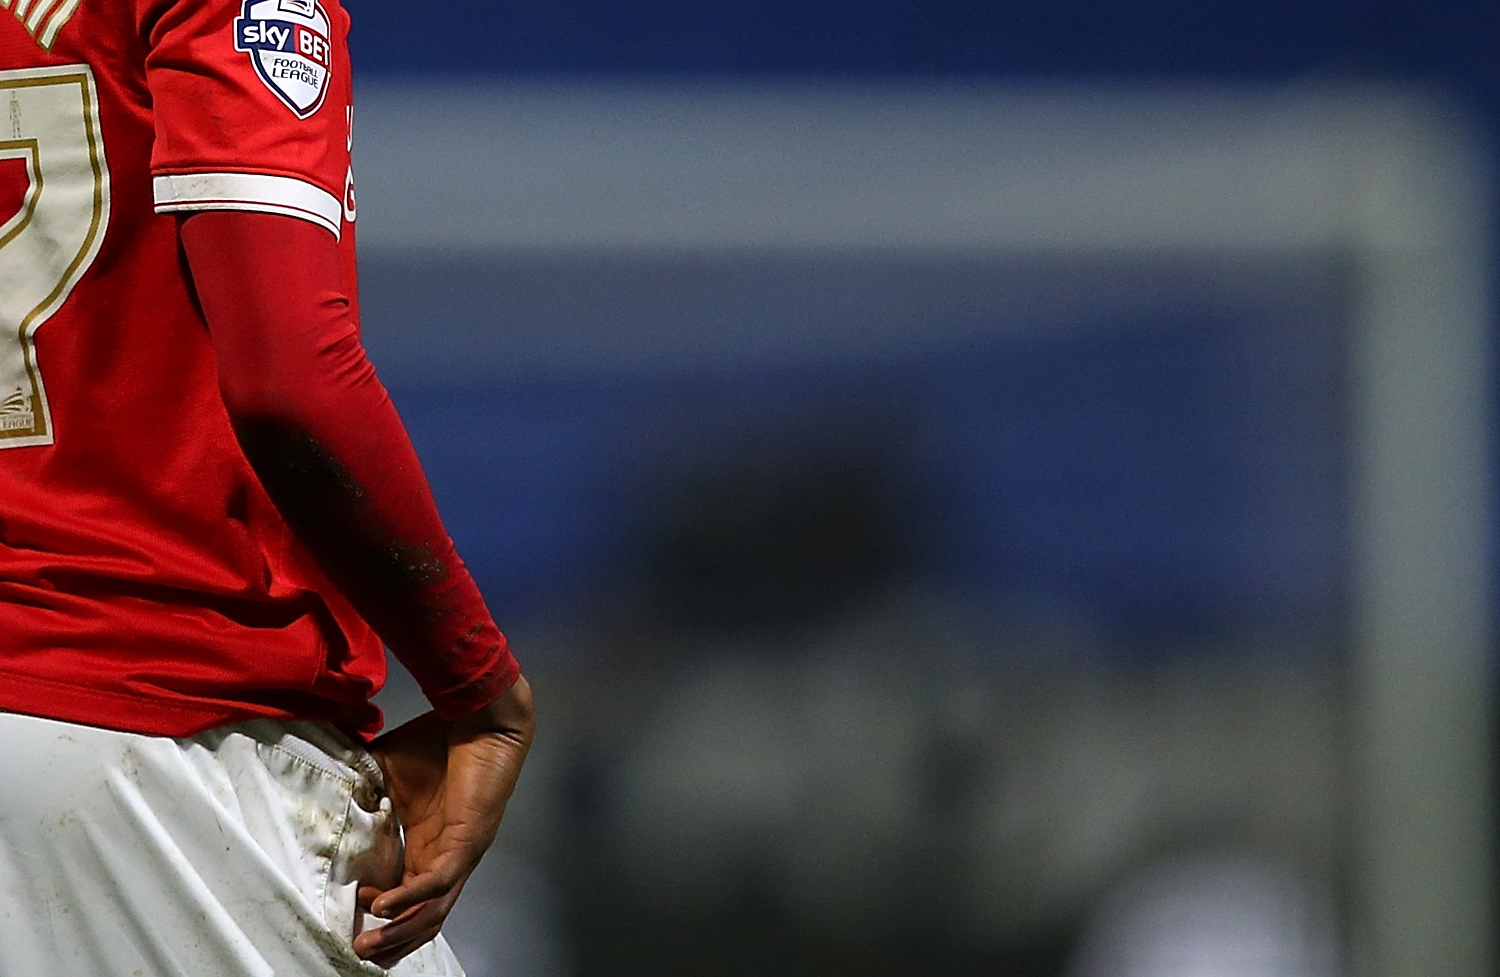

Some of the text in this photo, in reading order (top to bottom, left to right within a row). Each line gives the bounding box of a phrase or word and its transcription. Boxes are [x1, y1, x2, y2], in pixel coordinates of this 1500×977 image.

[243, 21, 329, 66] sky BET
[272, 67, 319, 89] LEAGUE
[273, 58, 318, 79] FOOTBALL
